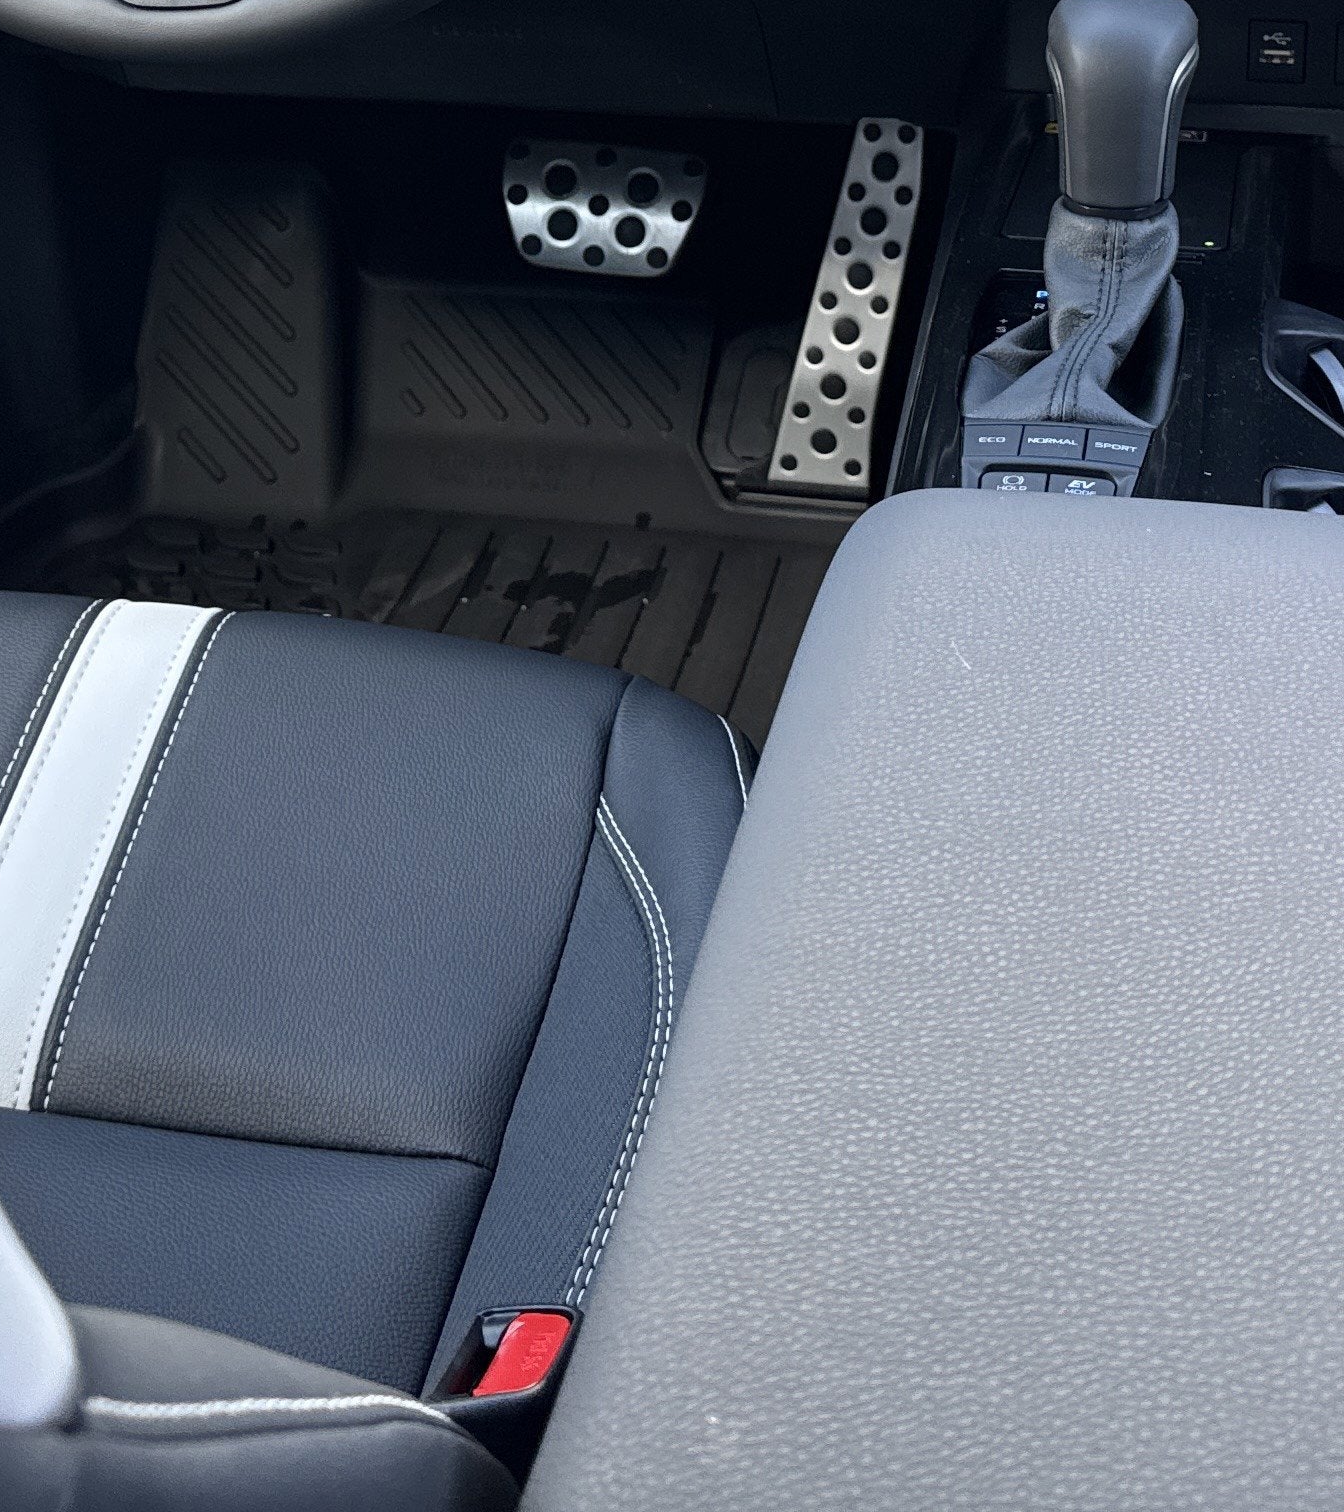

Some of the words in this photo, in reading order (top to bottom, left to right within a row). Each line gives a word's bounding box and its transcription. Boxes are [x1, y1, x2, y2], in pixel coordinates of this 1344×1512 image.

[978, 435, 1006, 444] ECO
[1027, 437, 1079, 447] NORMAL
[1094, 441, 1138, 453] SPORT
[1067, 479, 1096, 489] EV
